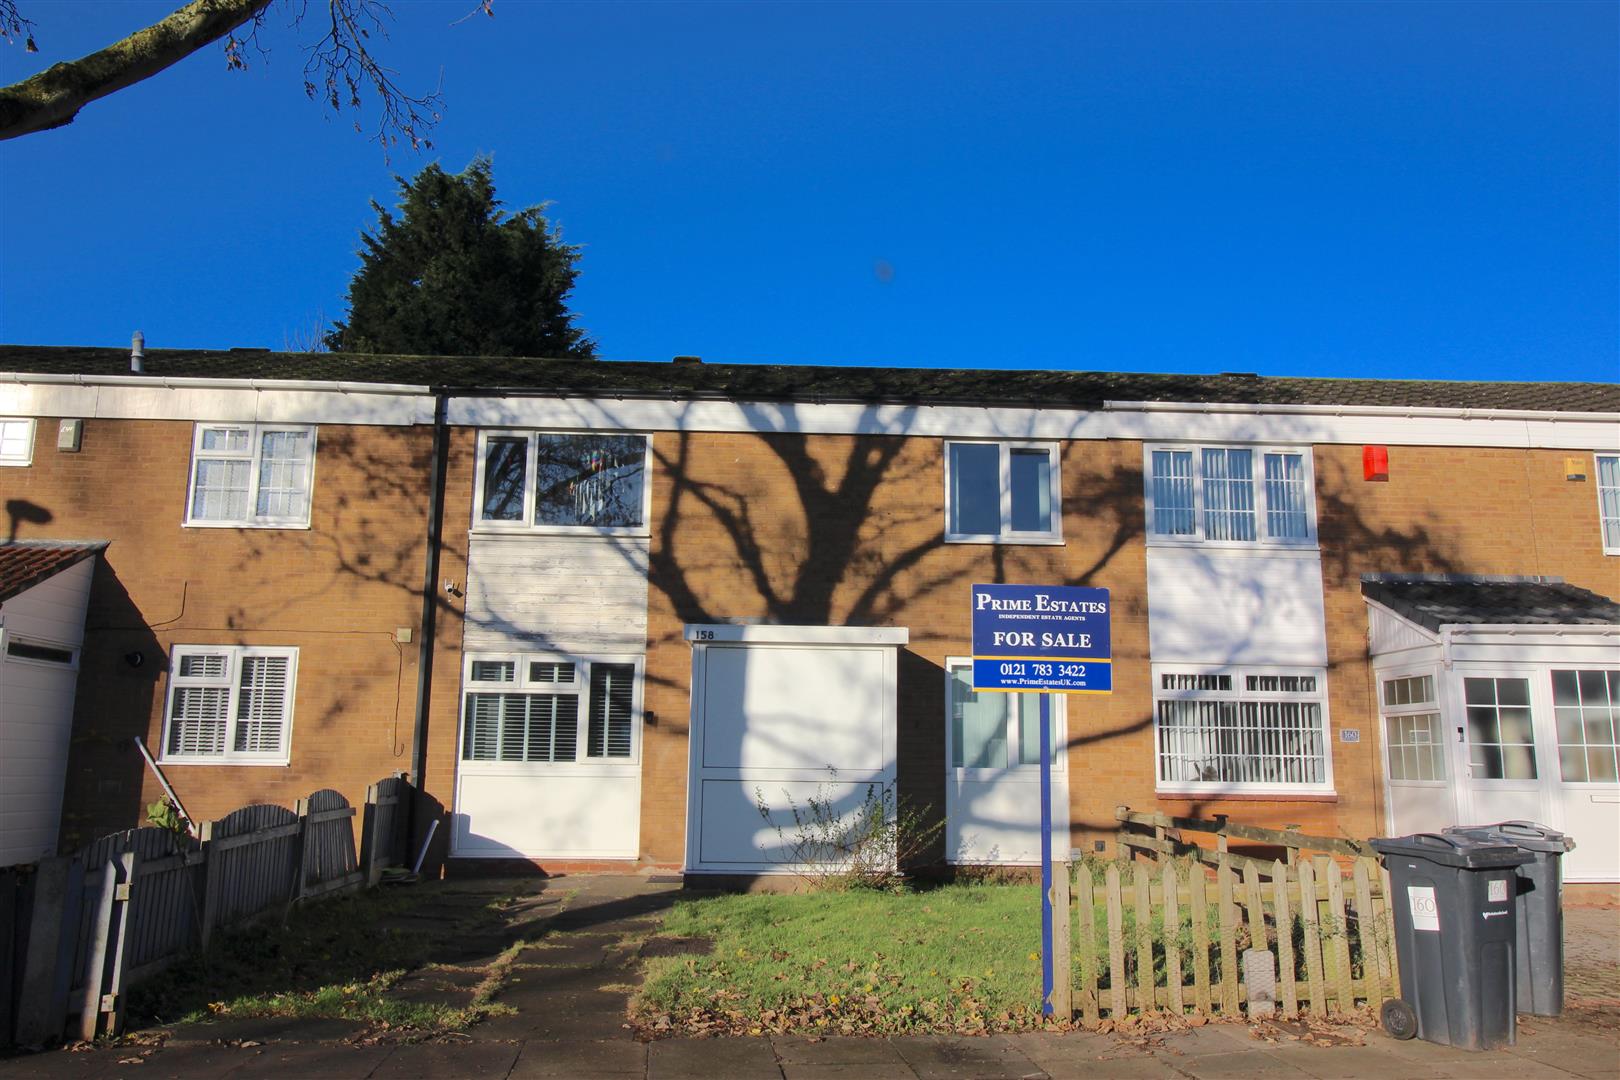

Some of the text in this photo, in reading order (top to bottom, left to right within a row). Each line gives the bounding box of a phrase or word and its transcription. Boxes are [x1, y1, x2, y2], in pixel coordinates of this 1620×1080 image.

[976, 593, 1107, 613] PRIME ESTATES
[695, 630, 714, 640] 158
[993, 631, 1092, 648] FOR SALE
[1000, 663, 1086, 677] 0121 783 3422
[1000, 678, 1087, 687] www.PrimeEstatesUK.com
[1412, 896, 1435, 912] 160
